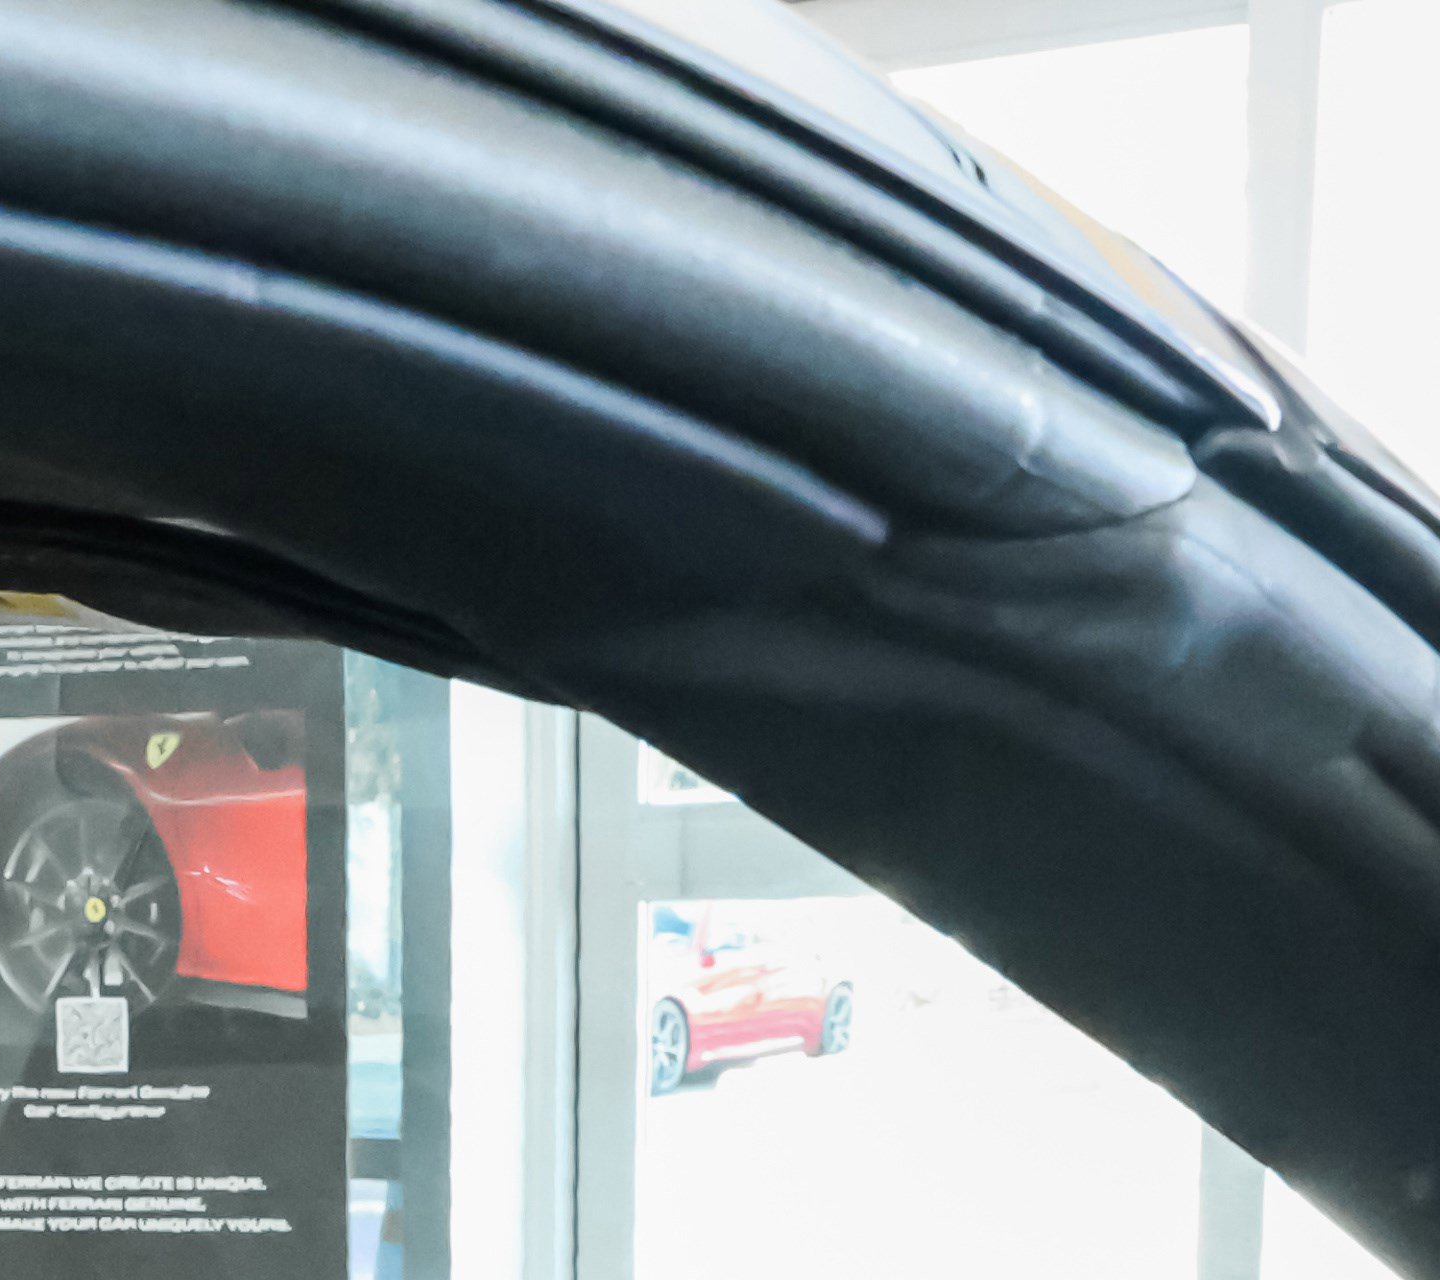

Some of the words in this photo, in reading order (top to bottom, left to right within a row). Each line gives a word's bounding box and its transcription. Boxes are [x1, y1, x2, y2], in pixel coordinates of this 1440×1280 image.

[77, 1085, 138, 1099] Ferrari
[56, 1104, 166, 1121] Configurator
[73, 1176, 103, 1190] WE
[104, 1175, 174, 1191] CREATE
[48, 1197, 123, 1212] FERRARI
[46, 1217, 97, 1231] YOUR
[98, 1217, 137, 1231] CAR
[138, 1217, 222, 1233] UNIQUELY
